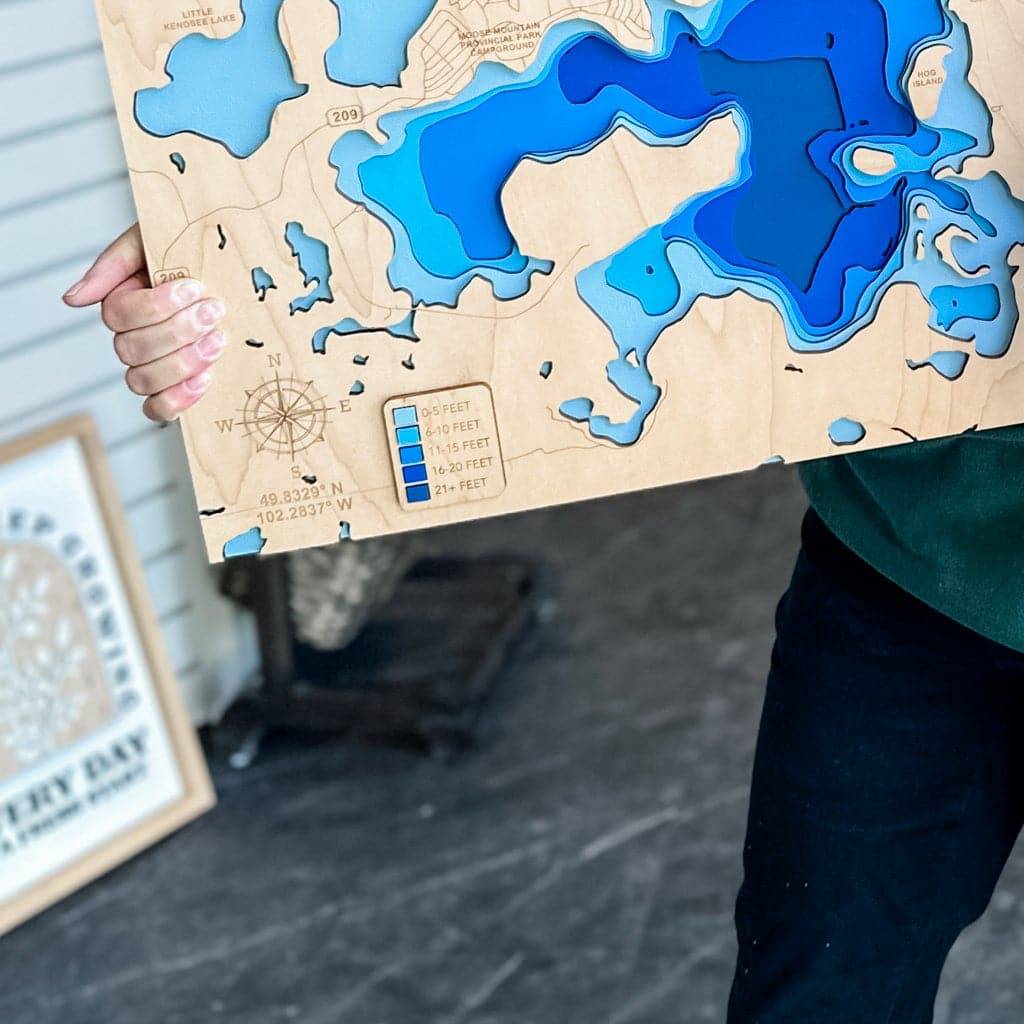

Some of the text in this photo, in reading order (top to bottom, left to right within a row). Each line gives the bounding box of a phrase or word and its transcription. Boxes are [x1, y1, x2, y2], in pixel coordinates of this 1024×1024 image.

[182, 8, 213, 19] LITTLE
[163, 14, 236, 31] KENOSEE LAKE
[458, 22, 541, 40] MOOSE MOUNTAIN
[460, 31, 541, 49] PROVINCIAL PARK
[470, 42, 534, 56] CAMPGROUND
[917, 69, 937, 77] HOG
[912, 77, 944, 88] ISLAND
[332, 109, 358, 122] 209
[267, 353, 282, 368] N
[215, 399, 352, 434] W E
[421, 401, 471, 418] 0-5 FEET
[425, 419, 480, 437] 6-10 FEET
[429, 437, 490, 456] 11-15 FEET
[290, 466, 301, 479] S
[432, 457, 493, 475] 16-20 FEET
[259, 482, 344, 507] 49.8329° N
[435, 477, 488, 496] 21+ FEET
[256, 497, 352, 525] 102.2837° W
